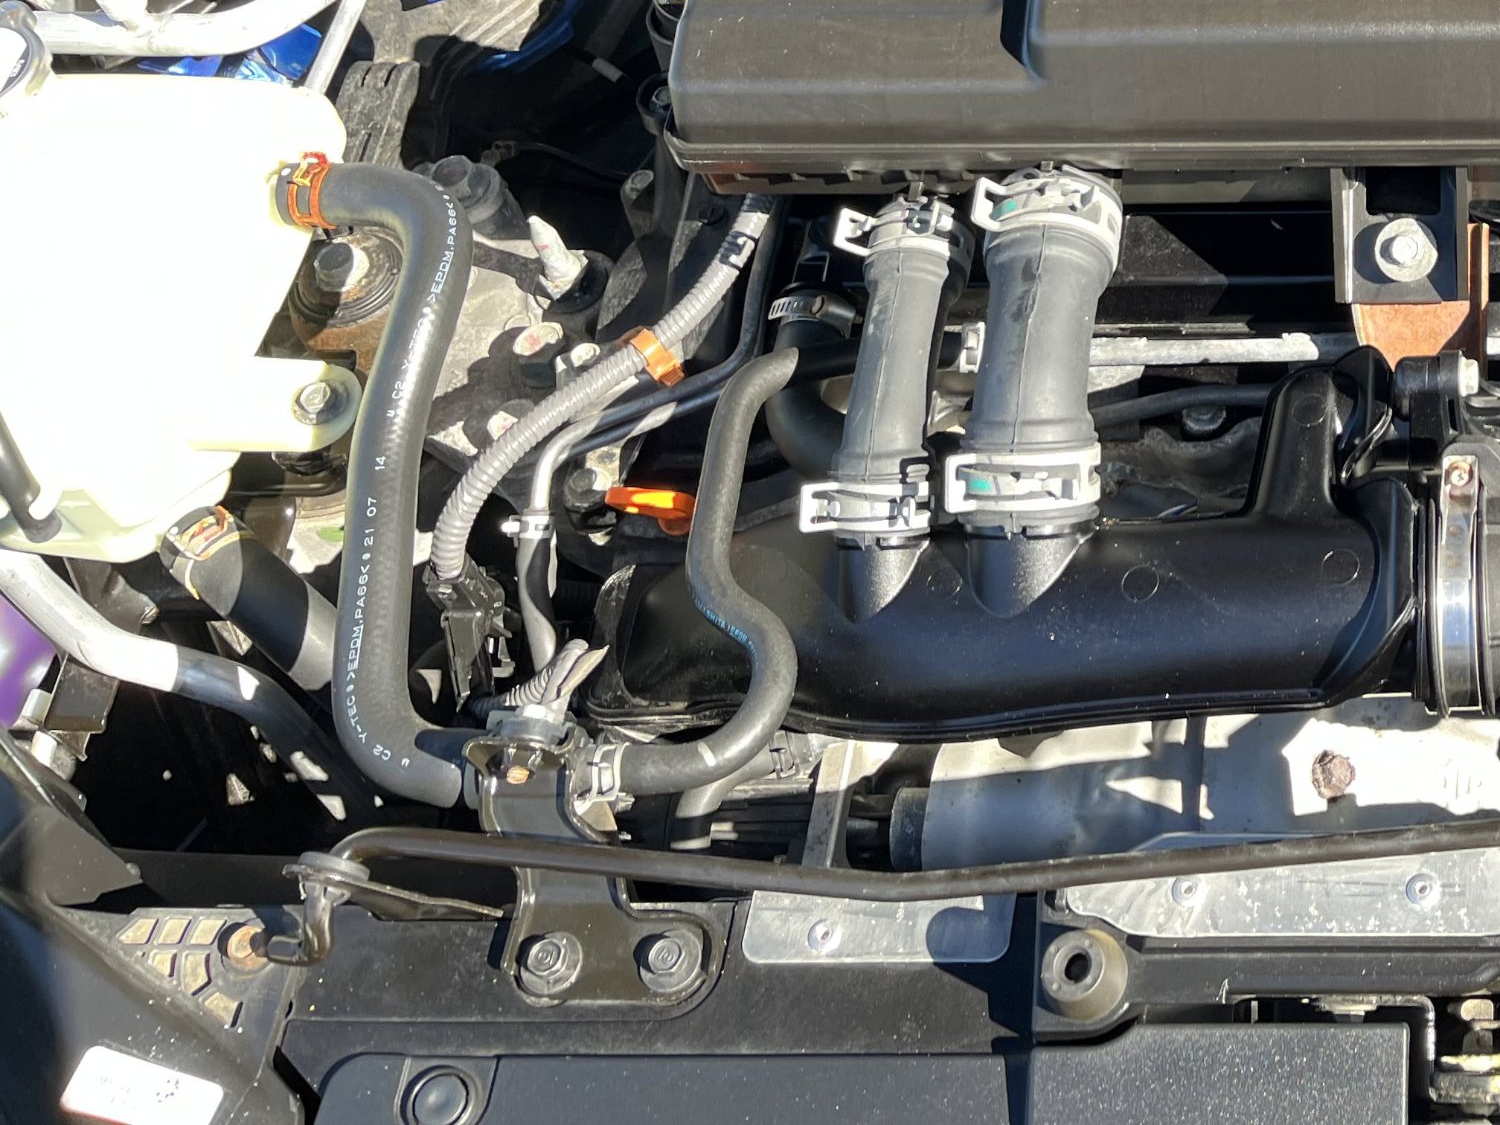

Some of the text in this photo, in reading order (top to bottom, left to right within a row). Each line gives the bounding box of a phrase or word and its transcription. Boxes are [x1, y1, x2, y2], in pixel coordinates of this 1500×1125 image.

[374, 455, 387, 471] 14
[366, 496, 378, 518] 07
[363, 527, 375, 547] 21
[346, 695, 368, 744] Y-TEC
[372, 744, 392, 761] C2
